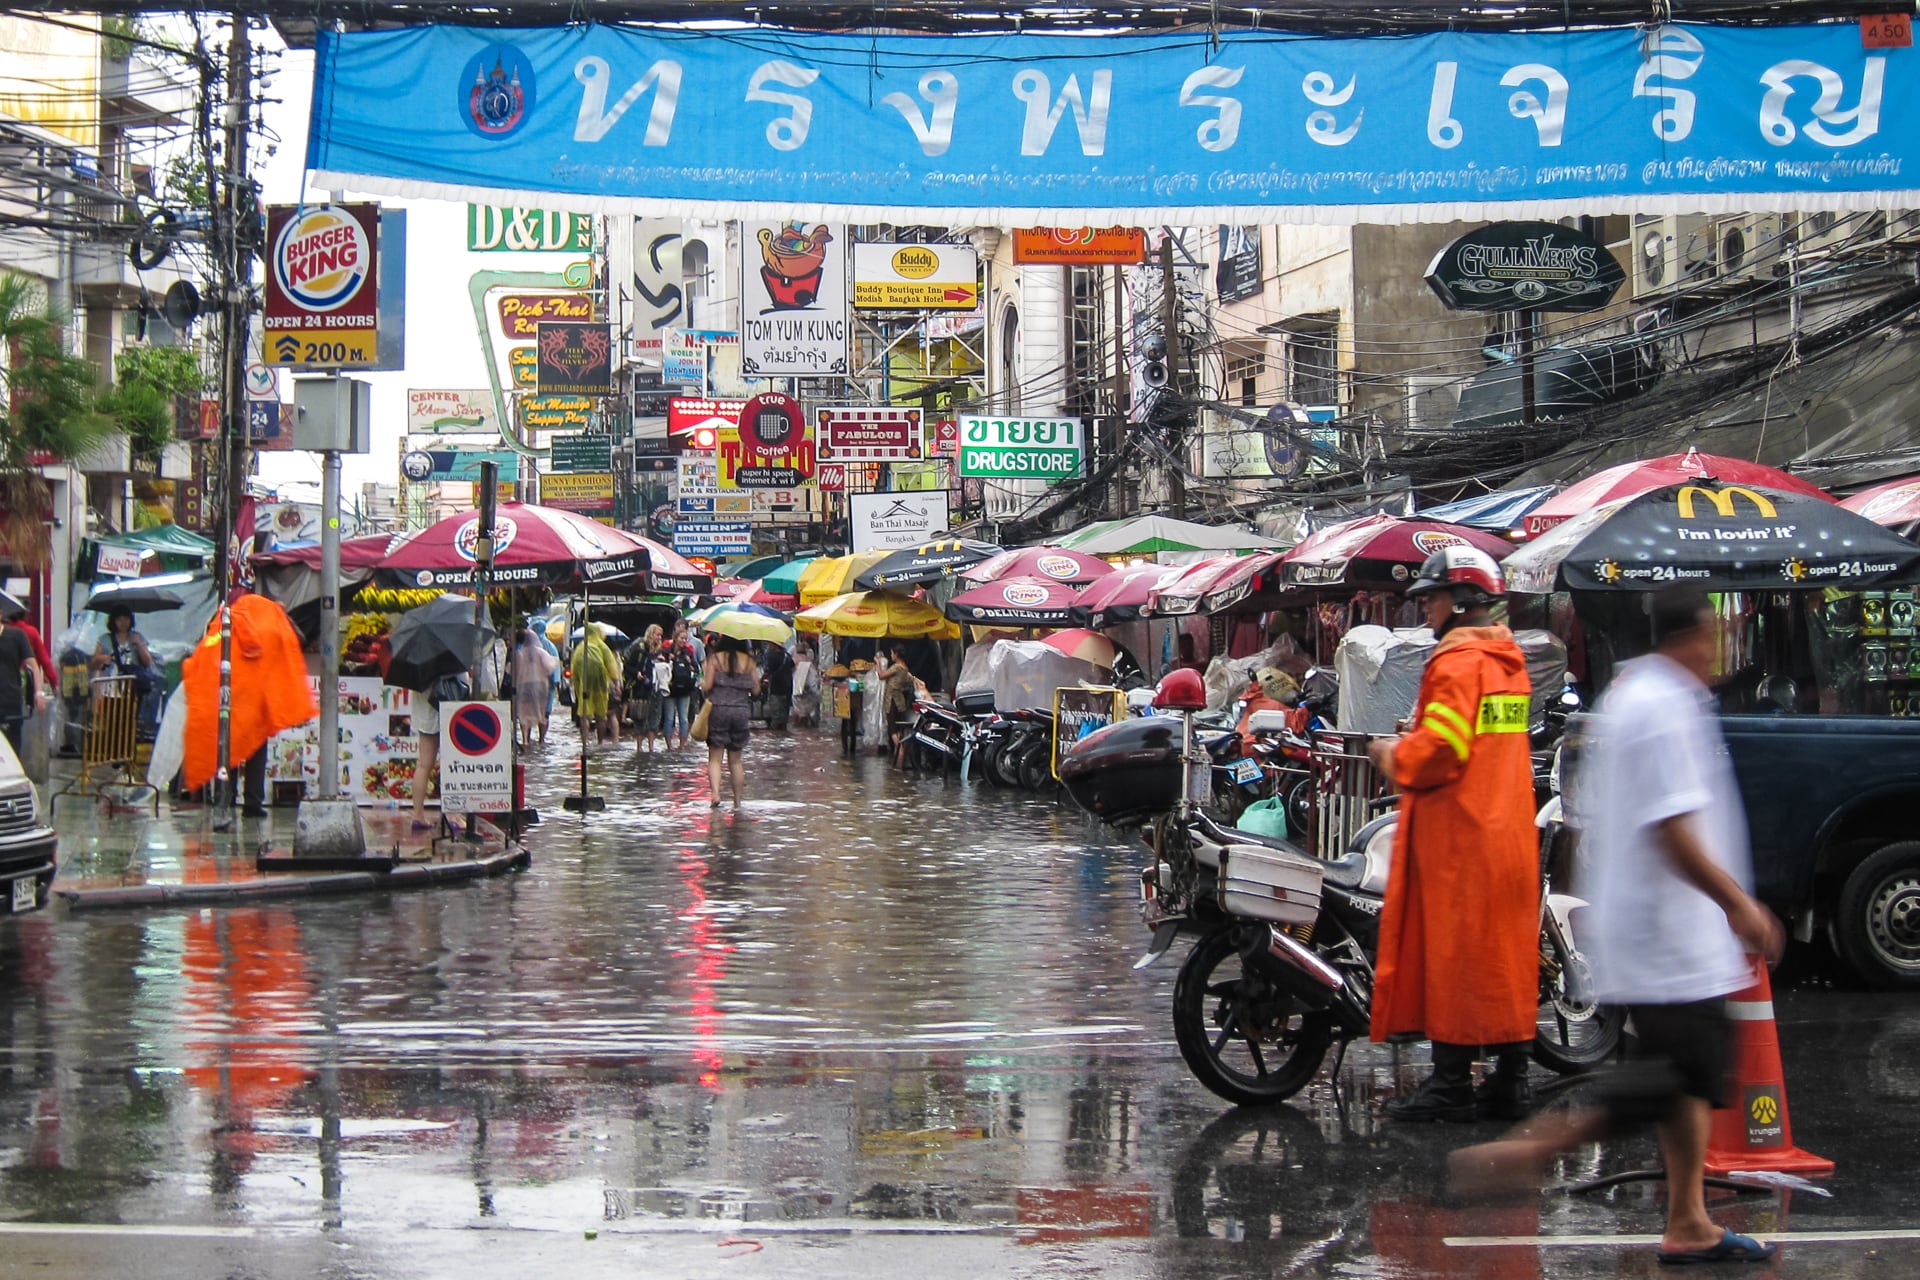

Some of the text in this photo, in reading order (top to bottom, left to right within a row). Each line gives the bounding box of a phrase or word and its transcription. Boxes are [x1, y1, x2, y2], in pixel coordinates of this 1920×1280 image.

[1868, 24, 1904, 38] 4.50
[472, 204, 572, 250] D&D
[287, 225, 355, 263] BURGER
[289, 242, 358, 289] KING
[899, 252, 932, 267] Buddy
[1537, 270, 1567, 279] TAVERN
[856, 286, 942, 295] Buddy Boutique Inn
[856, 295, 944, 304] Modish Bangkok Hotel
[265, 315, 375, 328] OPEN 24 HOURS
[746, 320, 843, 341] TOM YUM KUNG
[305, 343, 368, 362] 200 M.
[763, 346, 827, 369] ต้มยำกุ้ง
[411, 391, 460, 403] CENTER
[758, 394, 786, 406] true
[251, 412, 269, 425] 24
[837, 431, 902, 440] FABULOUS
[967, 419, 1074, 445] ขายยา
[755, 445, 790, 457] coffee
[967, 452, 1074, 471] DRUGSTORE
[741, 470, 762, 478] super
[772, 469, 794, 477] speed
[820, 467, 844, 489] illy
[741, 477, 770, 485] internet
[870, 518, 929, 529] Ban Thai Masaje
[885, 535, 916, 544] Bangkok
[1678, 527, 1713, 541] i'm
[1715, 527, 1772, 541] lovin'
[1421, 537, 1462, 546] BURGER
[1045, 563, 1075, 573] KING
[1623, 565, 1711, 581] open 24 hours
[1808, 561, 1897, 577] open 24 hours
[435, 567, 539, 584] OPEN HOURS
[984, 608, 1041, 619] DELIVERY
[448, 760, 504, 774] ห้ามจอด
[1349, 897, 1379, 917] POLICE
